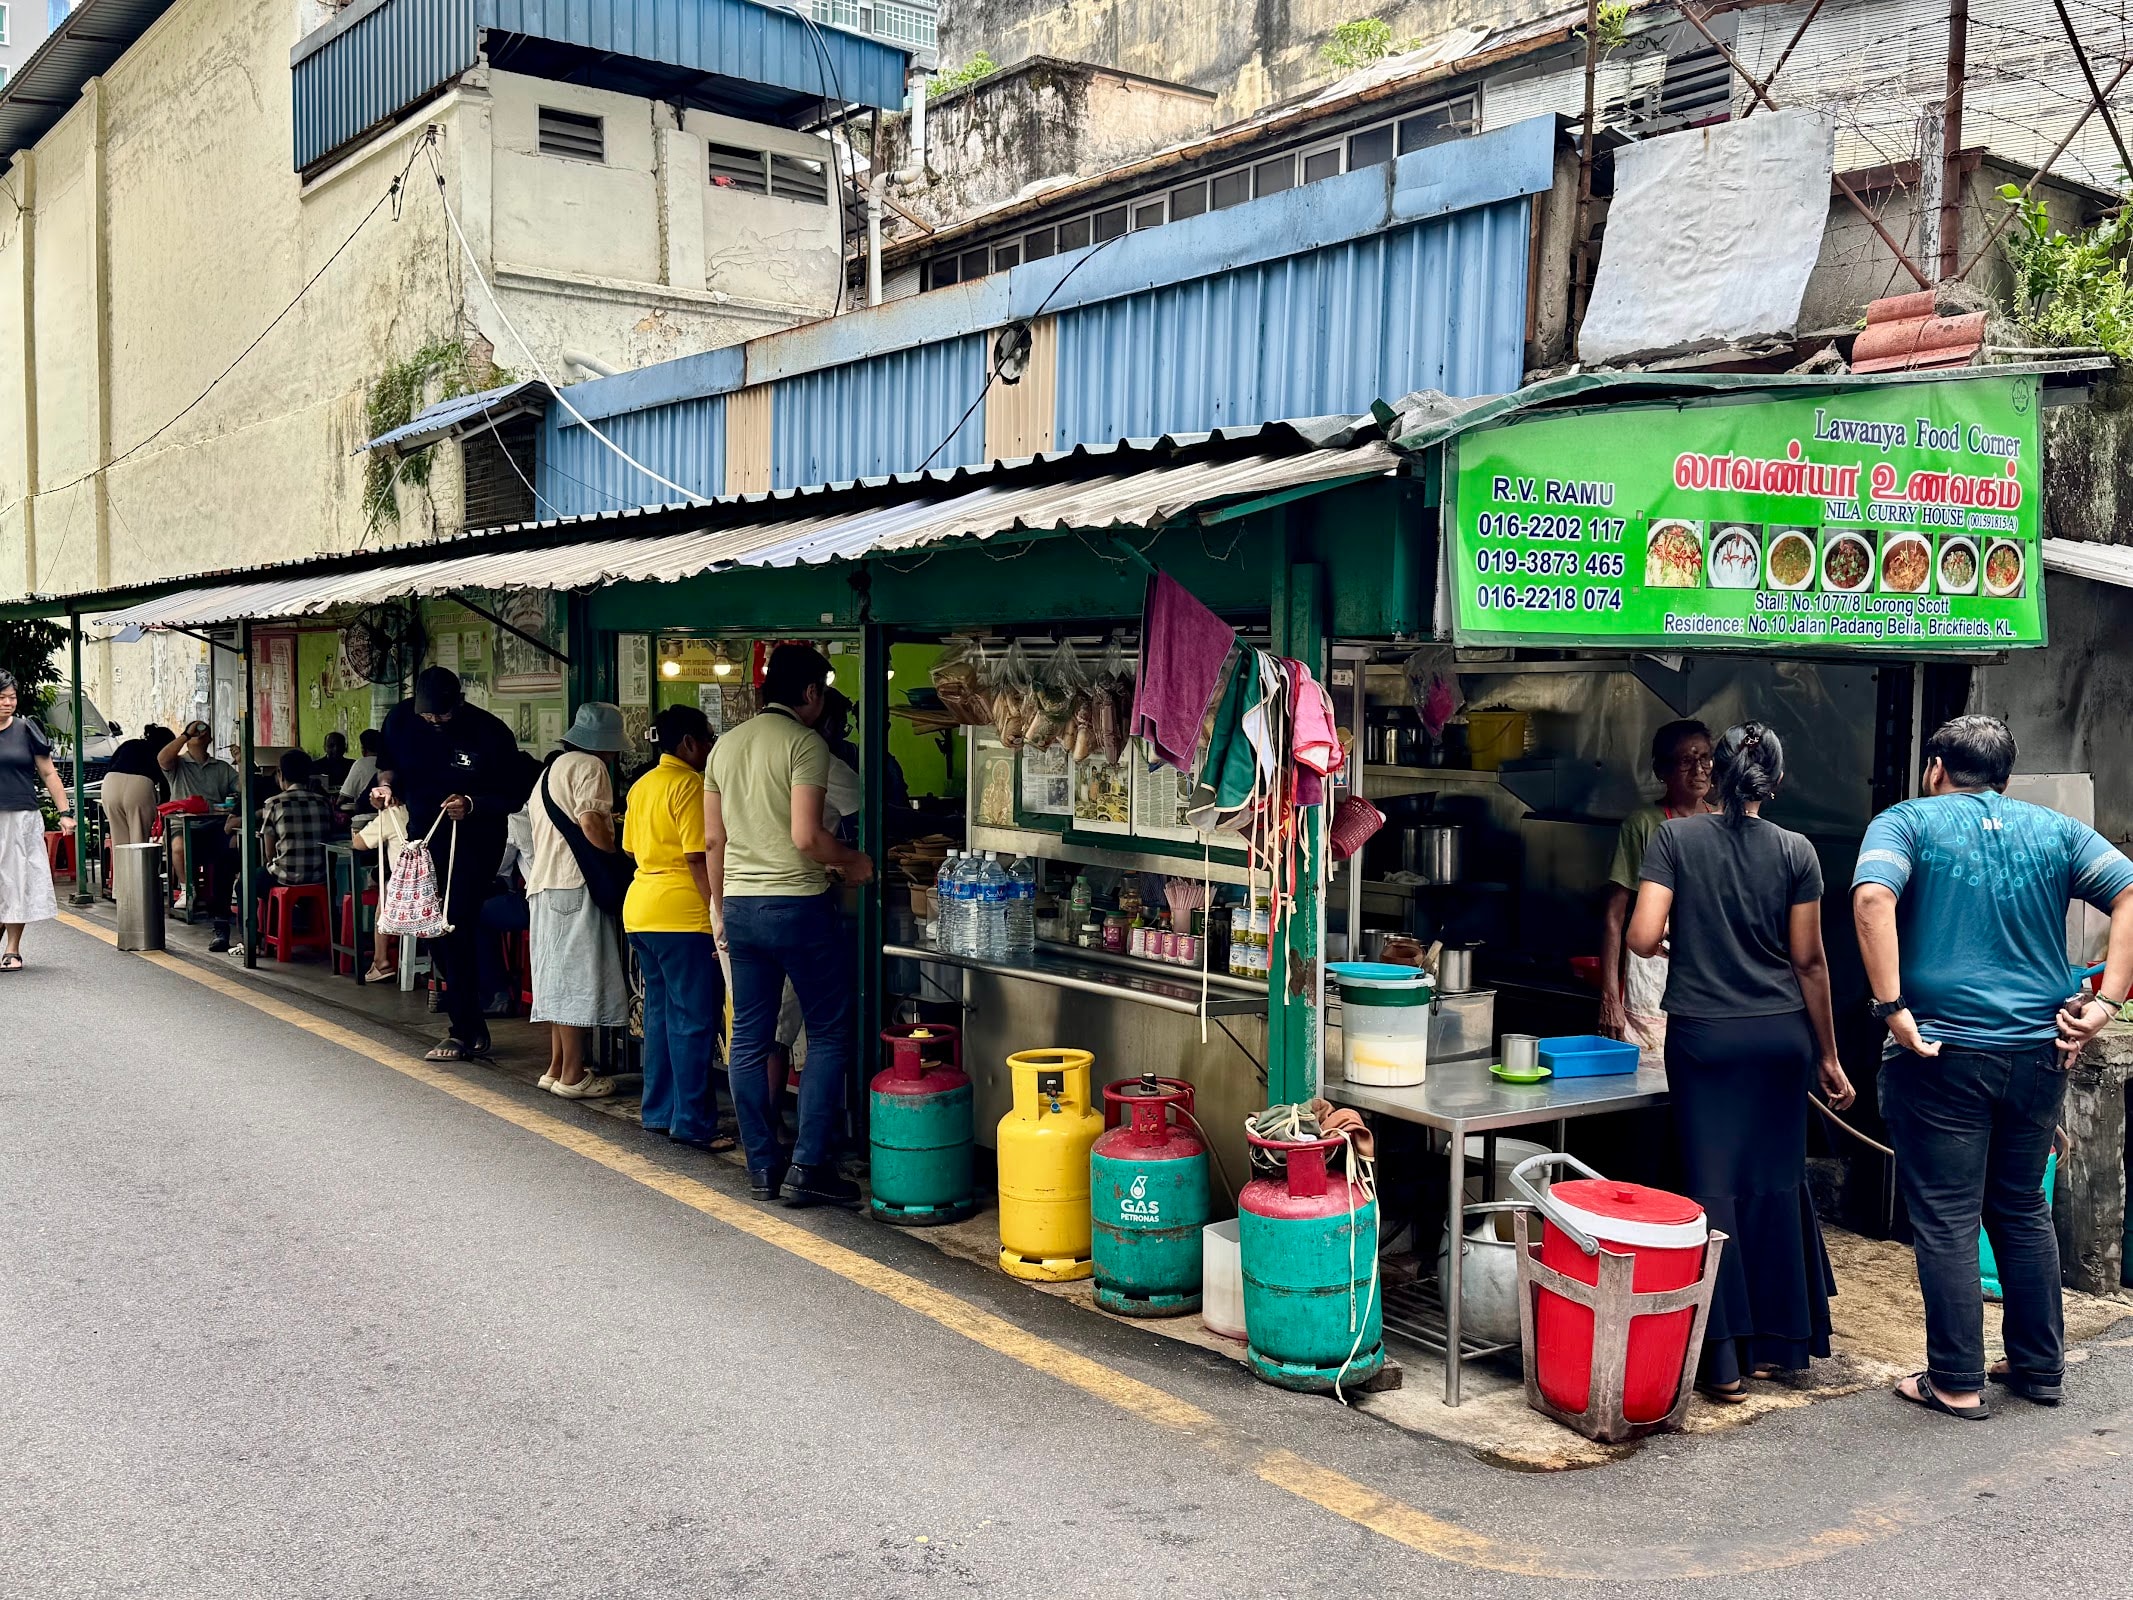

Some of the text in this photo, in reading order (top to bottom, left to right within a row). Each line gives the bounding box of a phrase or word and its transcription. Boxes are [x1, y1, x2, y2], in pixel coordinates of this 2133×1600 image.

[1814, 409, 2020, 458] Lawanya Food Corner
[1674, 439, 2022, 510] லாவண்யா உணவகம்
[1493, 476, 1614, 506] R.V. RAMU
[1825, 501, 1862, 522] NILA
[1867, 503, 1918, 524] CURRY
[1922, 506, 1963, 526] HOUSE
[1478, 513, 1625, 541] 016-2202 117
[1477, 549, 1624, 576] 019-3873 465
[1478, 585, 1622, 611] 016-2218 074
[1754, 592, 1949, 617] Stall: No.1077/8 Lorong Scott
[1664, 613, 2017, 638] Residence: No.10 Jalan Padang Belia, Brickfields, KL.
[1120, 1199, 1160, 1214] GAS
[1120, 1213, 1160, 1222] PETRONAS
